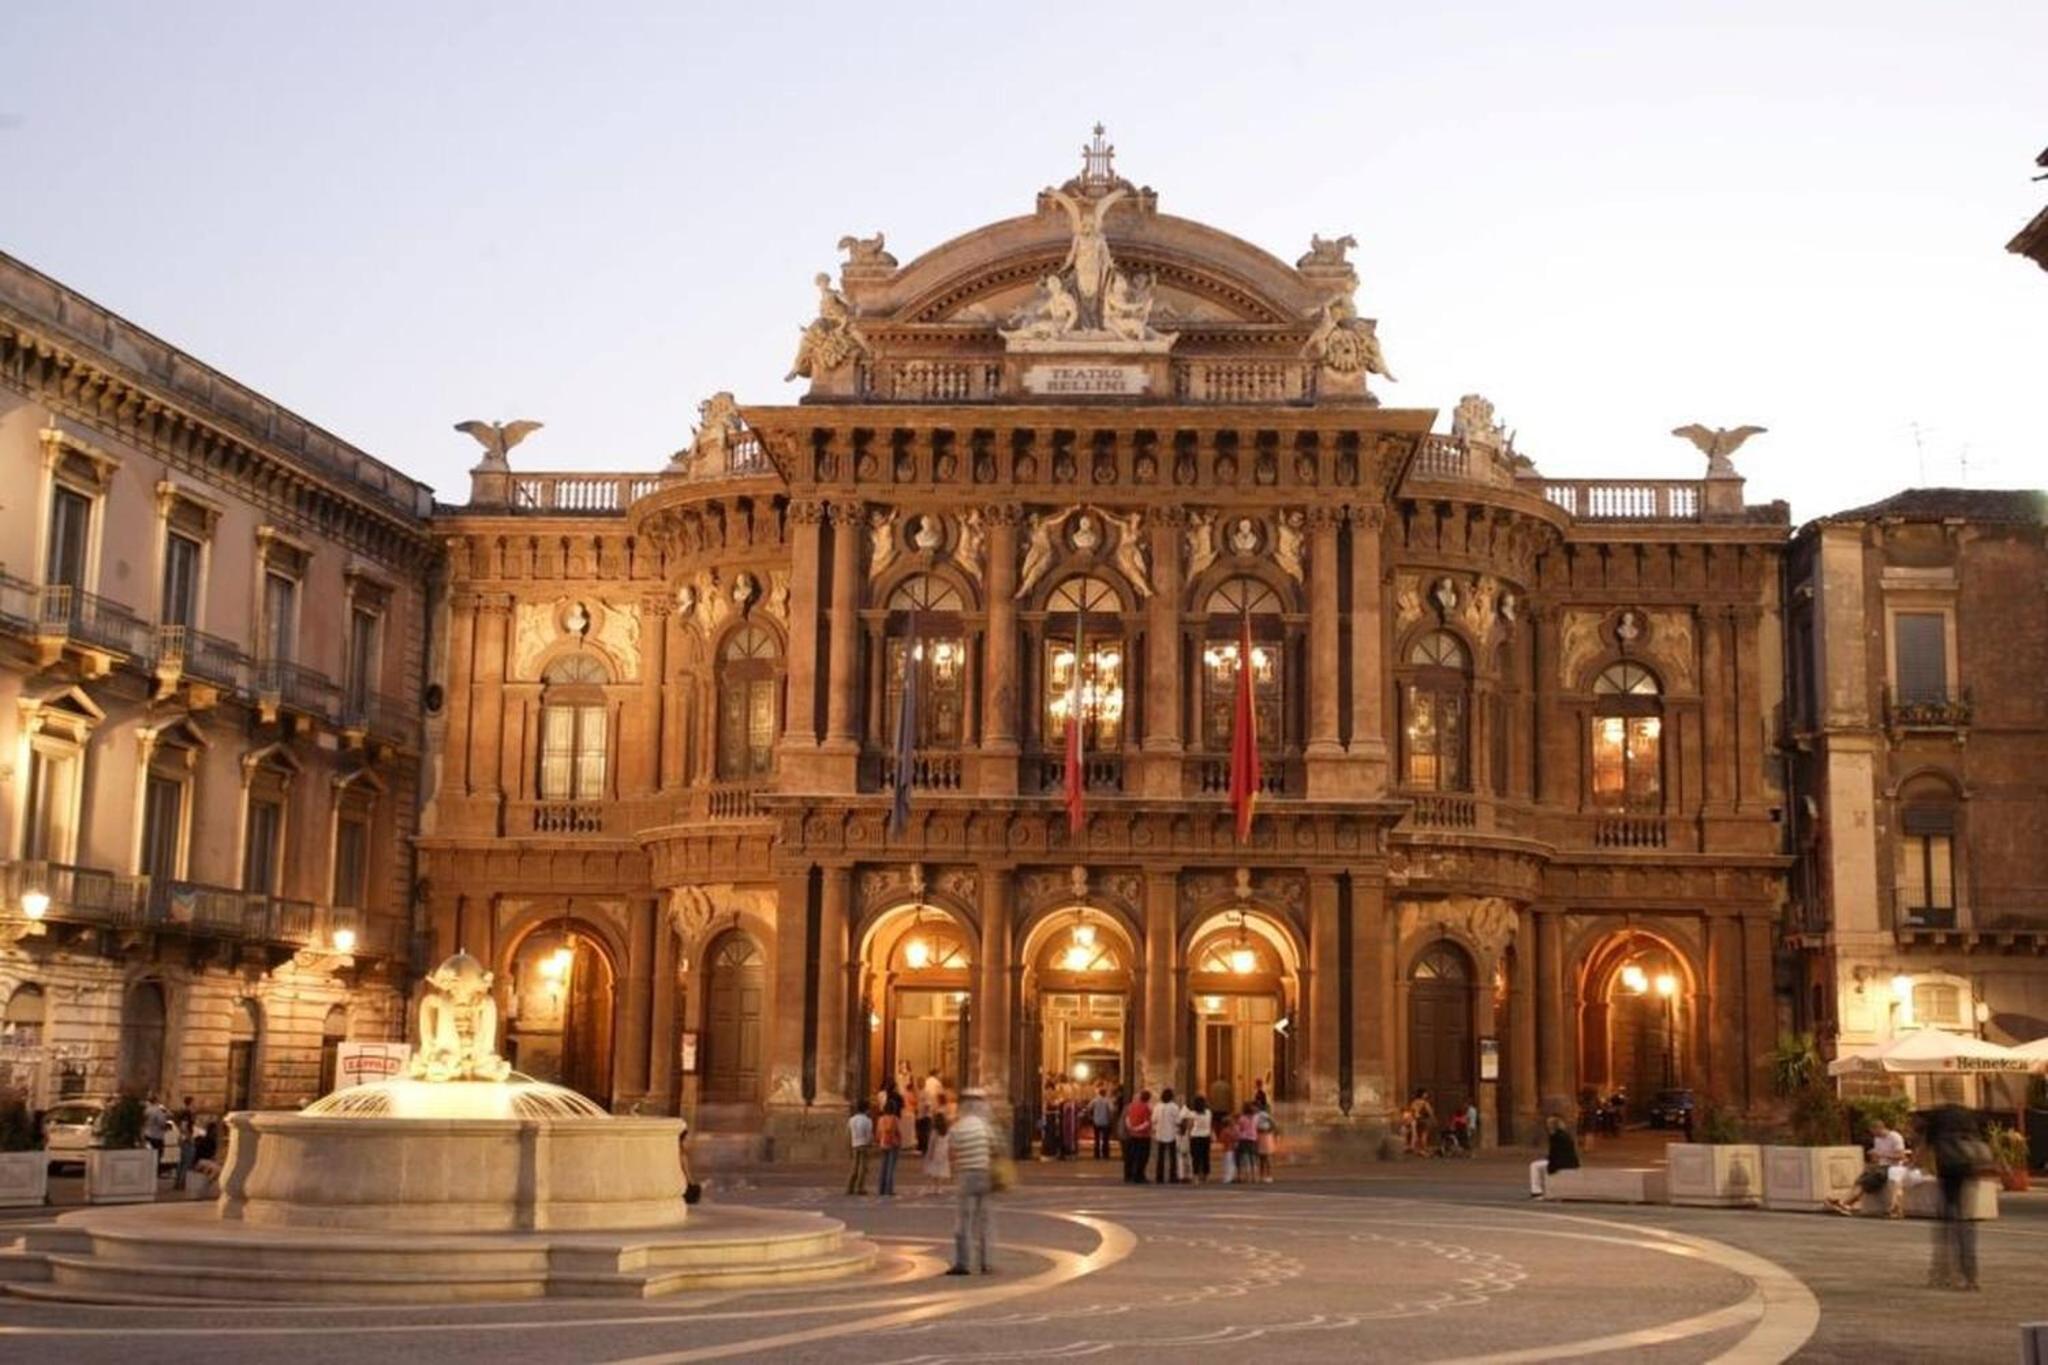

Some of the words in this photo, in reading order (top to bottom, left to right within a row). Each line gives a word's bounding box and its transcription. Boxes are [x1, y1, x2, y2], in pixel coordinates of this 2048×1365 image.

[1052, 369, 1123, 379] TEATRO
[1047, 381, 1126, 391] BELLINI
[1956, 1055, 2029, 1070] Heineken
